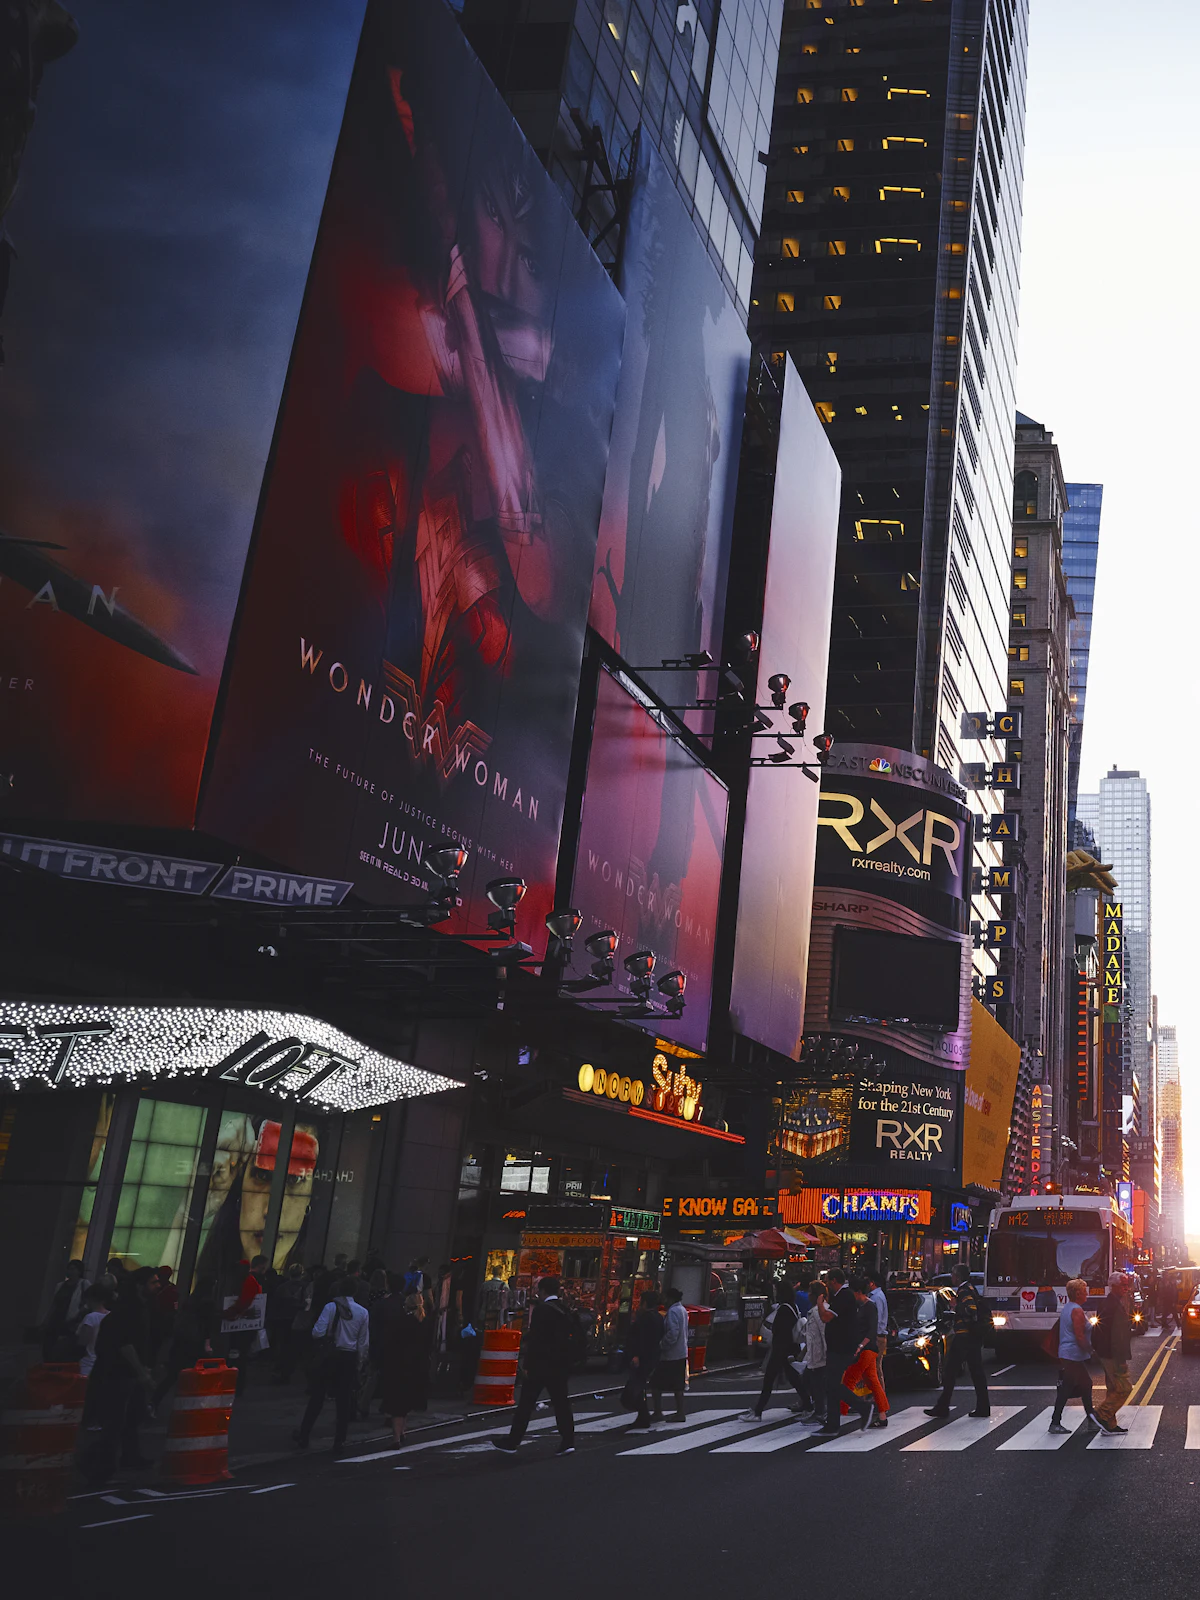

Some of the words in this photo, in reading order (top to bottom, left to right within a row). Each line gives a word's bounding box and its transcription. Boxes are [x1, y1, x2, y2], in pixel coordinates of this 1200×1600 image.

[300, 637, 438, 754] WONDER
[455, 744, 538, 822] WOMAN
[309, 748, 328, 768] THE
[336, 764, 374, 794] FUTURE
[381, 790, 394, 803] OF
[399, 801, 436, 829] JUSTICE
[441, 823, 472, 849] BEGINS
[477, 844, 496, 862] WITH
[501, 858, 514, 872] HER
[378, 821, 432, 865] JUN
[817, 791, 960, 877] RXR
[360, 850, 370, 863] SEE
[852, 856, 931, 881] rxrrealty.com
[992, 716, 1014, 997] CHAMPS
[231, 872, 336, 905] PRIME
[588, 849, 655, 912] WONDER
[664, 903, 711, 946] WOMAN
[813, 901, 869, 913] SHARP
[1104, 904, 1122, 1004] MADAME
[212, 1030, 357, 1100] LOFT
[911, 1083, 934, 1097] New
[935, 1086, 952, 1100] York
[858, 1097, 878, 1110] for
[880, 1098, 899, 1112] the
[900, 1101, 921, 1115] 21st
[922, 1102, 954, 1122] Century
[875, 1118, 942, 1152] RXR
[889, 1149, 932, 1161] REALTY
[679, 1198, 727, 1216] KNOW
[822, 1194, 919, 1219] CHAMPS
[1008, 1211, 1028, 1226] M42
[525, 1236, 558, 1245] HALAL
[570, 1236, 600, 1246] FOOD
[838, 1232, 868, 1242] HAMPS
